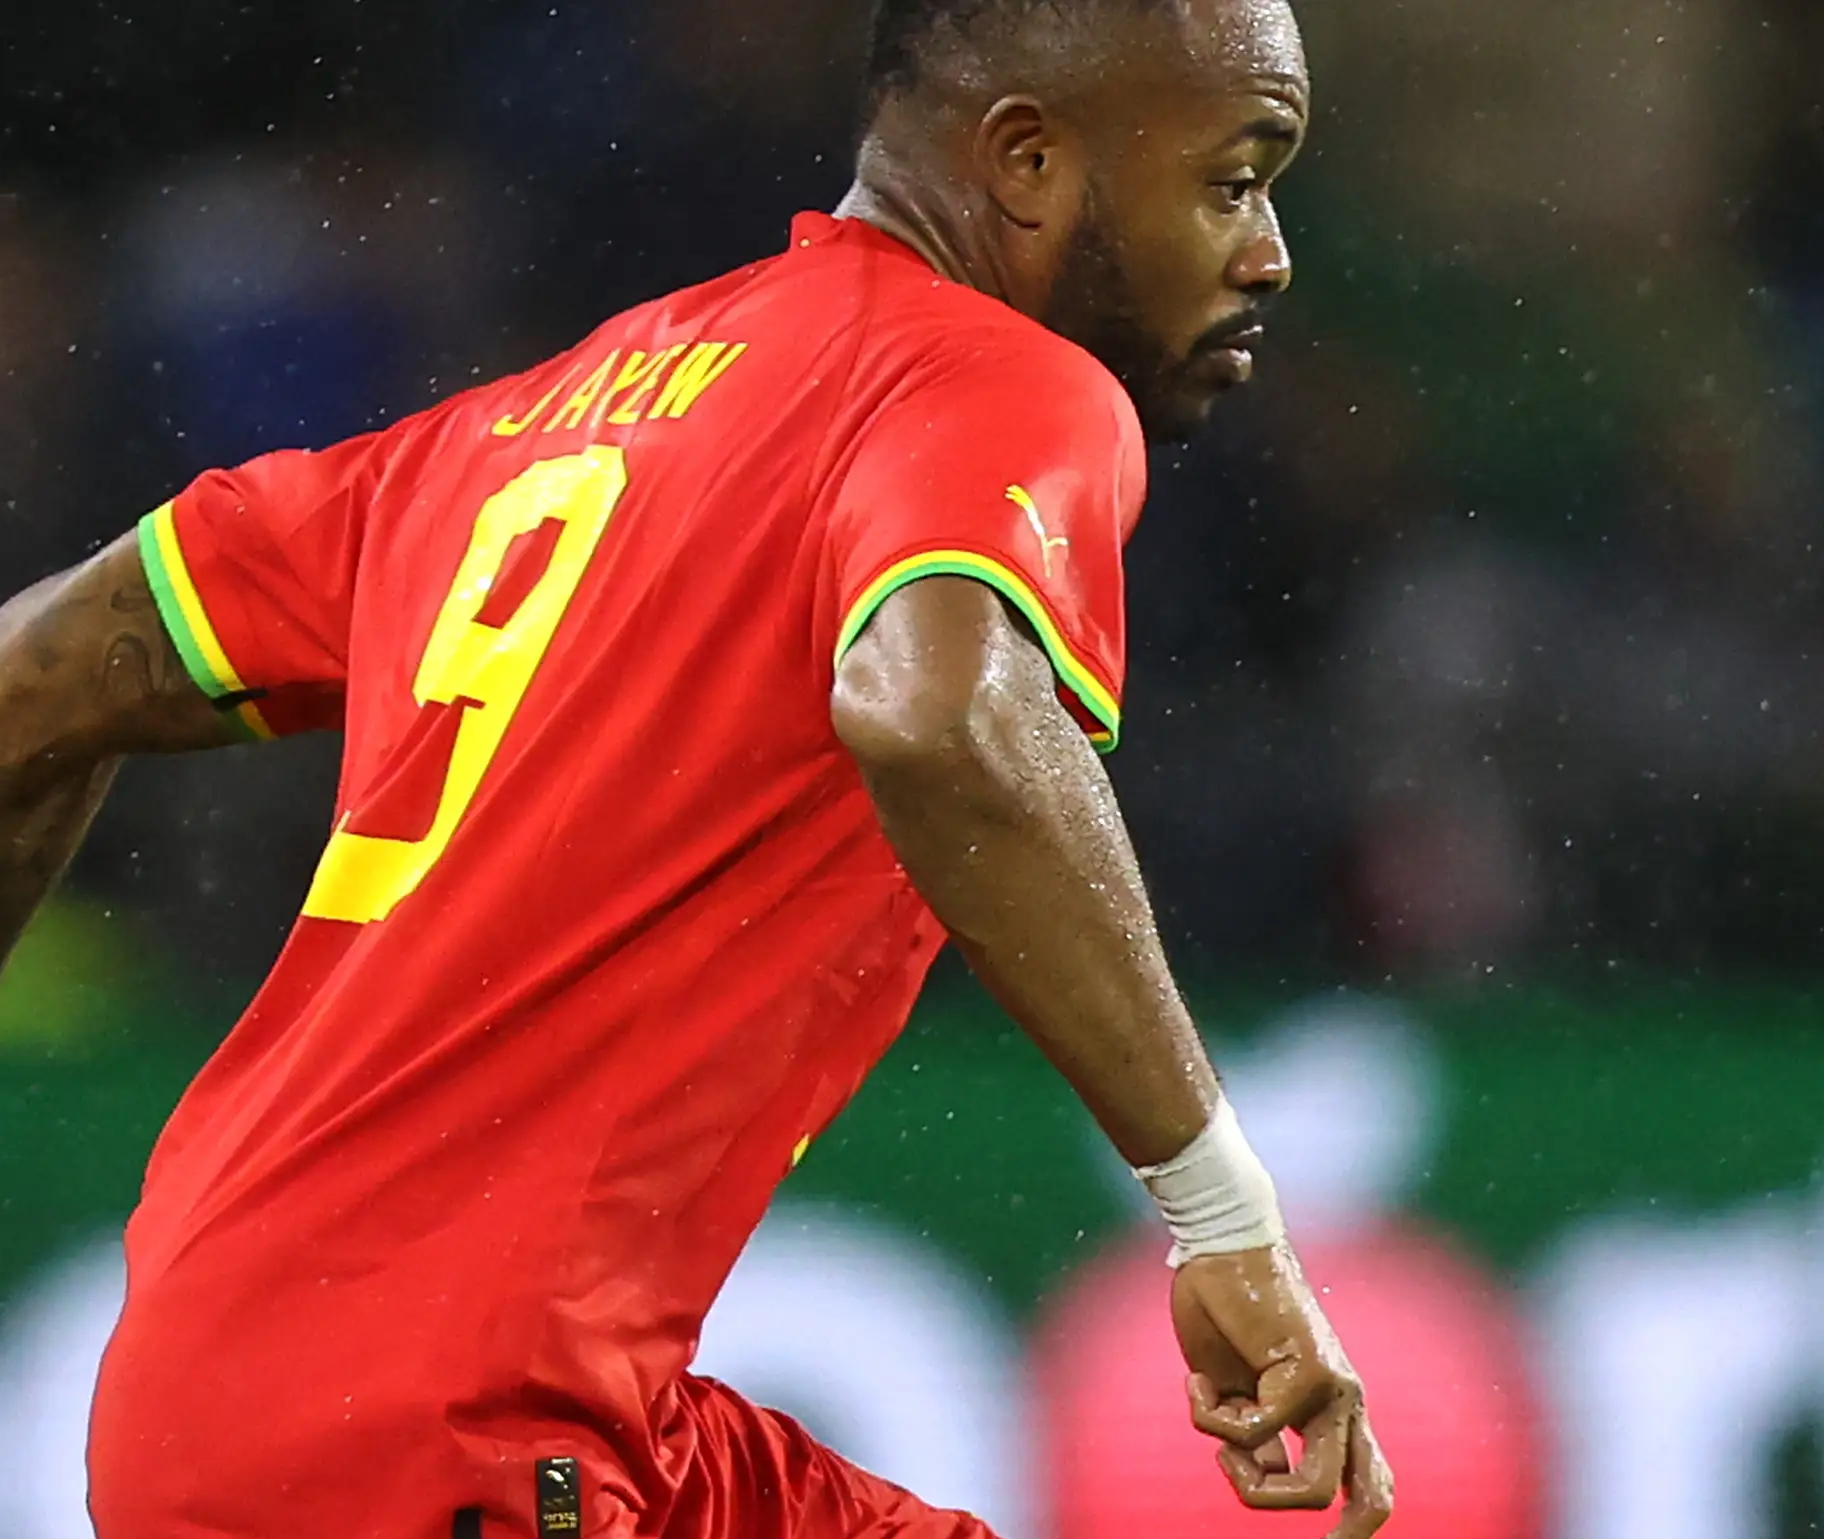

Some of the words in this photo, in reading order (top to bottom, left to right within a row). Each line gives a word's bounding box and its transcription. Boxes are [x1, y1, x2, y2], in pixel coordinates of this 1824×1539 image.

[491, 362, 583, 436] J
[541, 342, 749, 433] AYEW
[302, 444, 628, 922] 9
